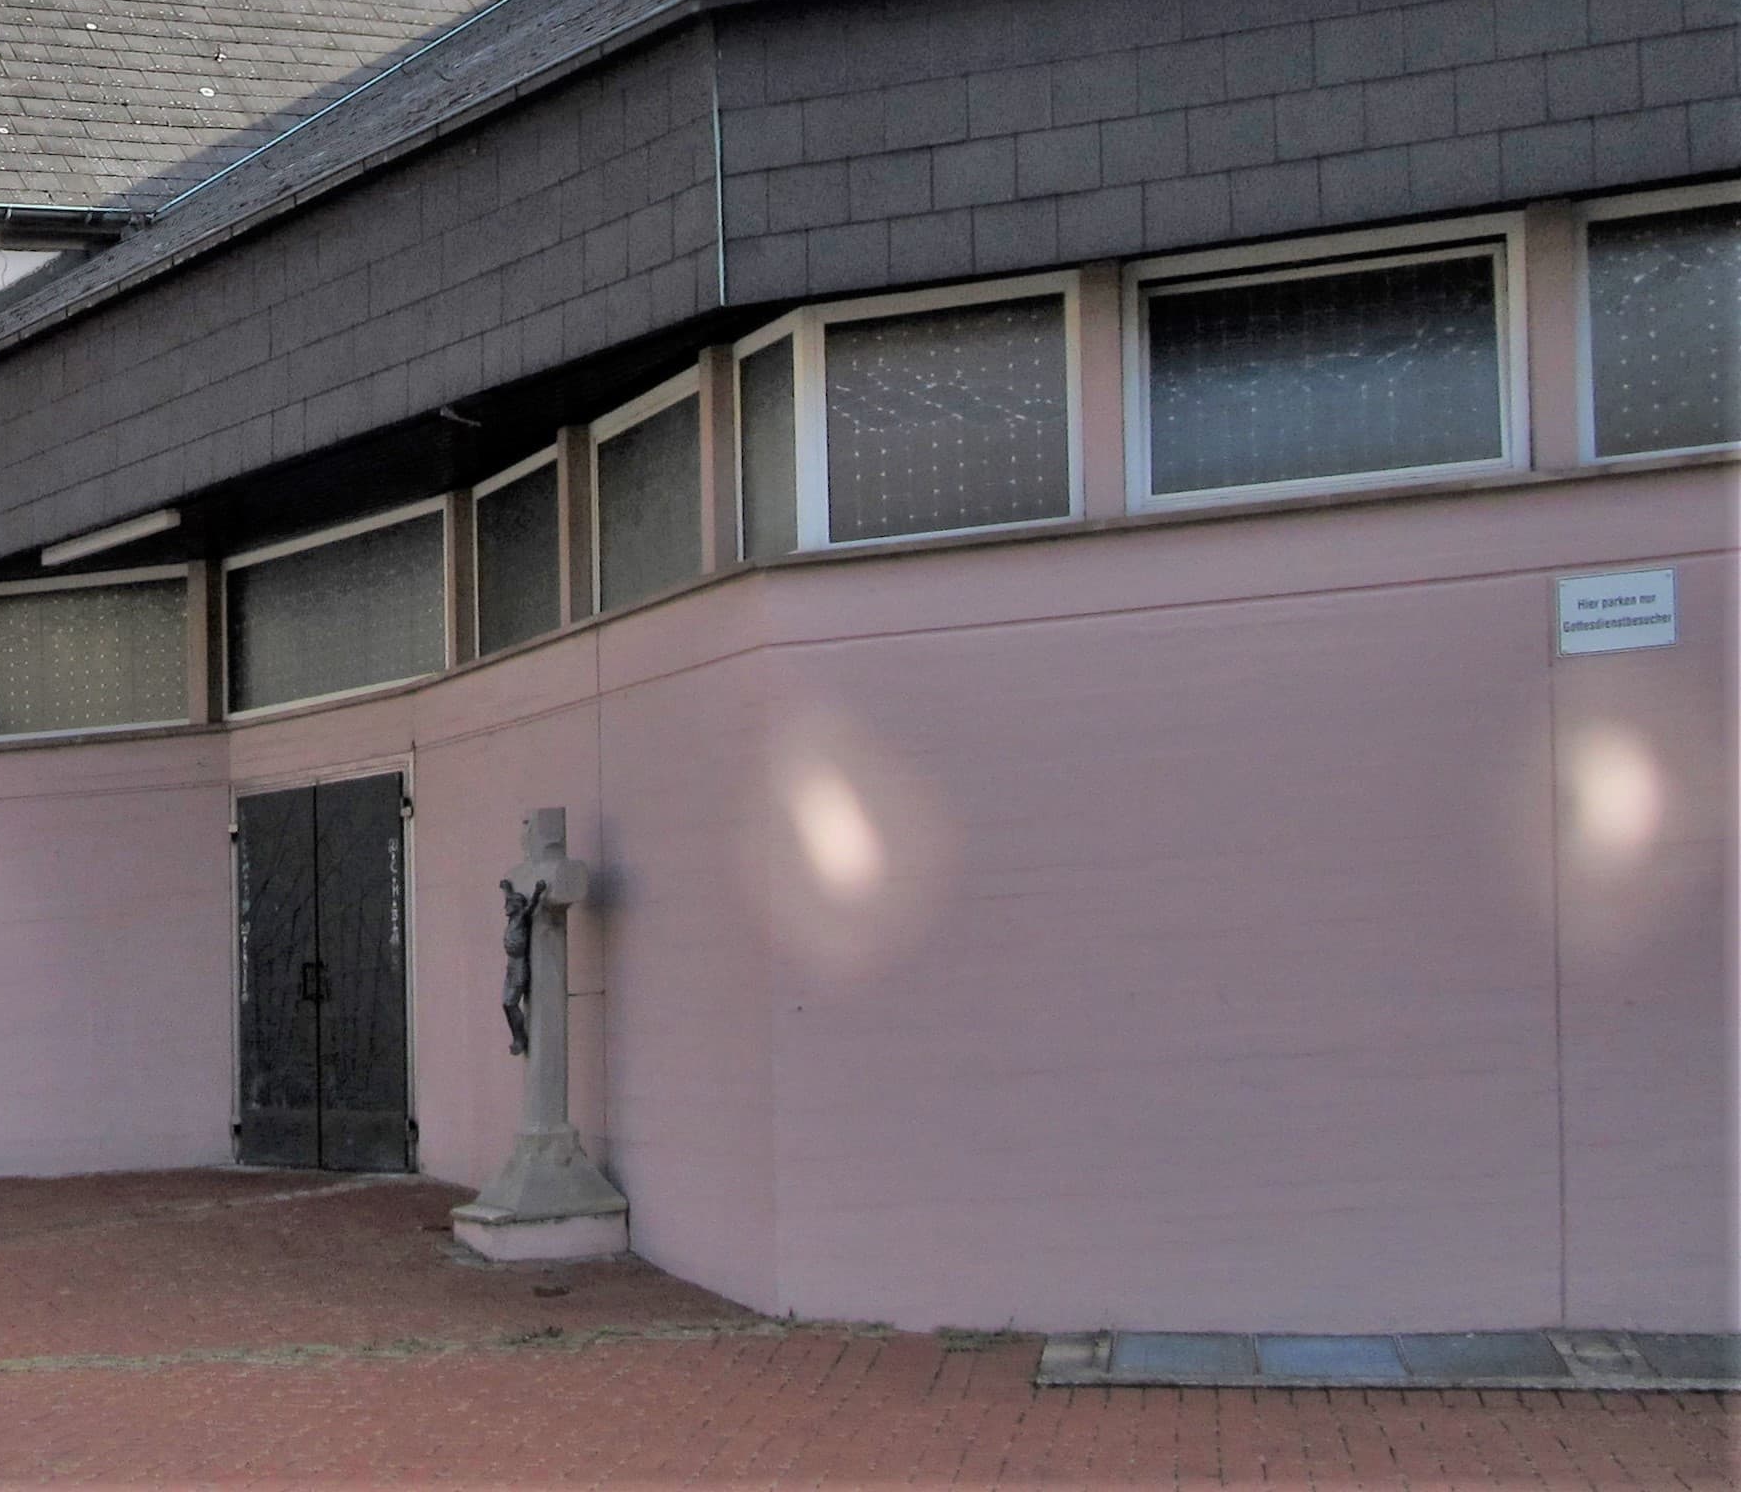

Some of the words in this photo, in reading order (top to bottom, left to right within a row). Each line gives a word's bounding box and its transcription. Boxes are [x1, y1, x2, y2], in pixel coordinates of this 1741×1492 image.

[1578, 598, 1599, 610] Hier
[1602, 596, 1637, 610] parken
[1640, 594, 1657, 604] nur
[1563, 613, 1672, 633] Gottesdienstbesucher
